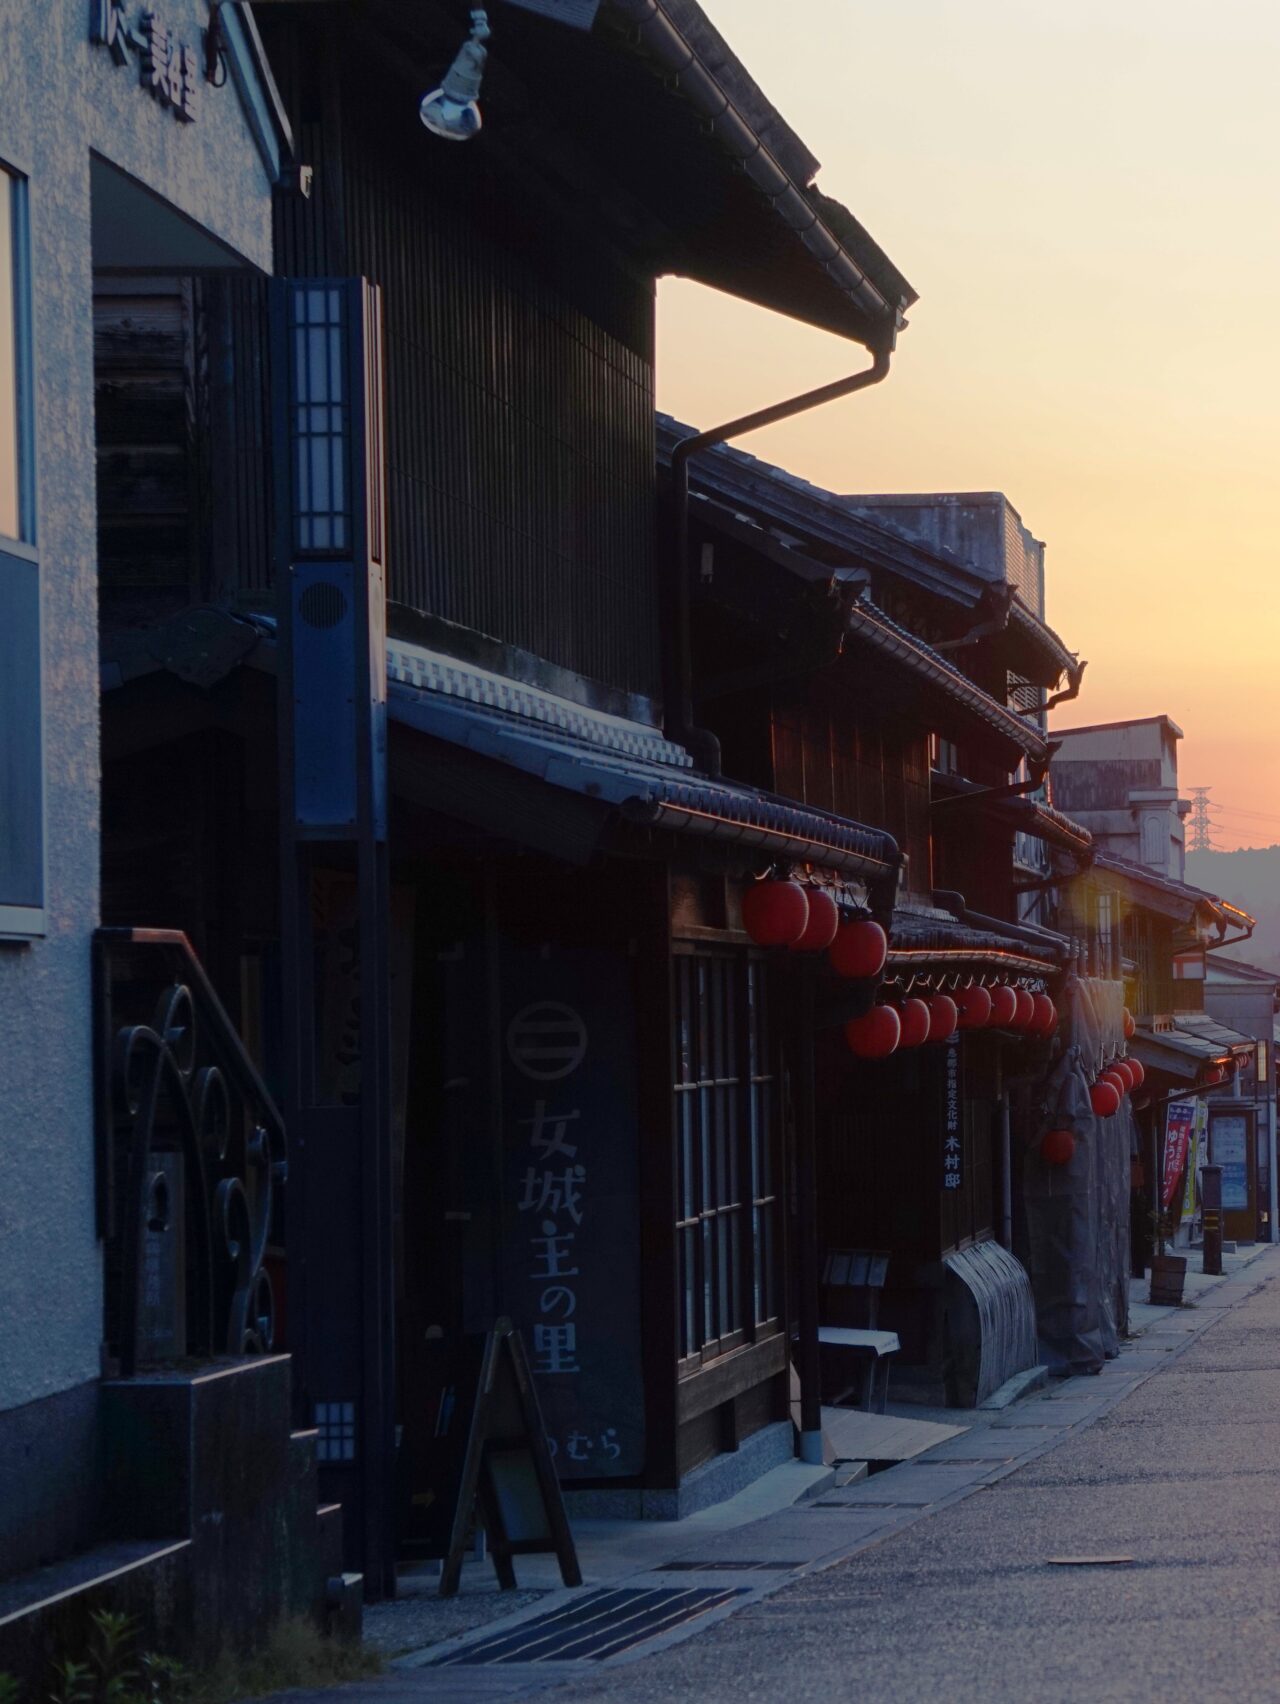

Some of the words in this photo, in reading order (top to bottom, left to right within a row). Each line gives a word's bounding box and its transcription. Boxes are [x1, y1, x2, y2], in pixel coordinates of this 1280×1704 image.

[517, 1100, 586, 1374] 女城主の里
[944, 1136, 961, 1189] 木村邸
